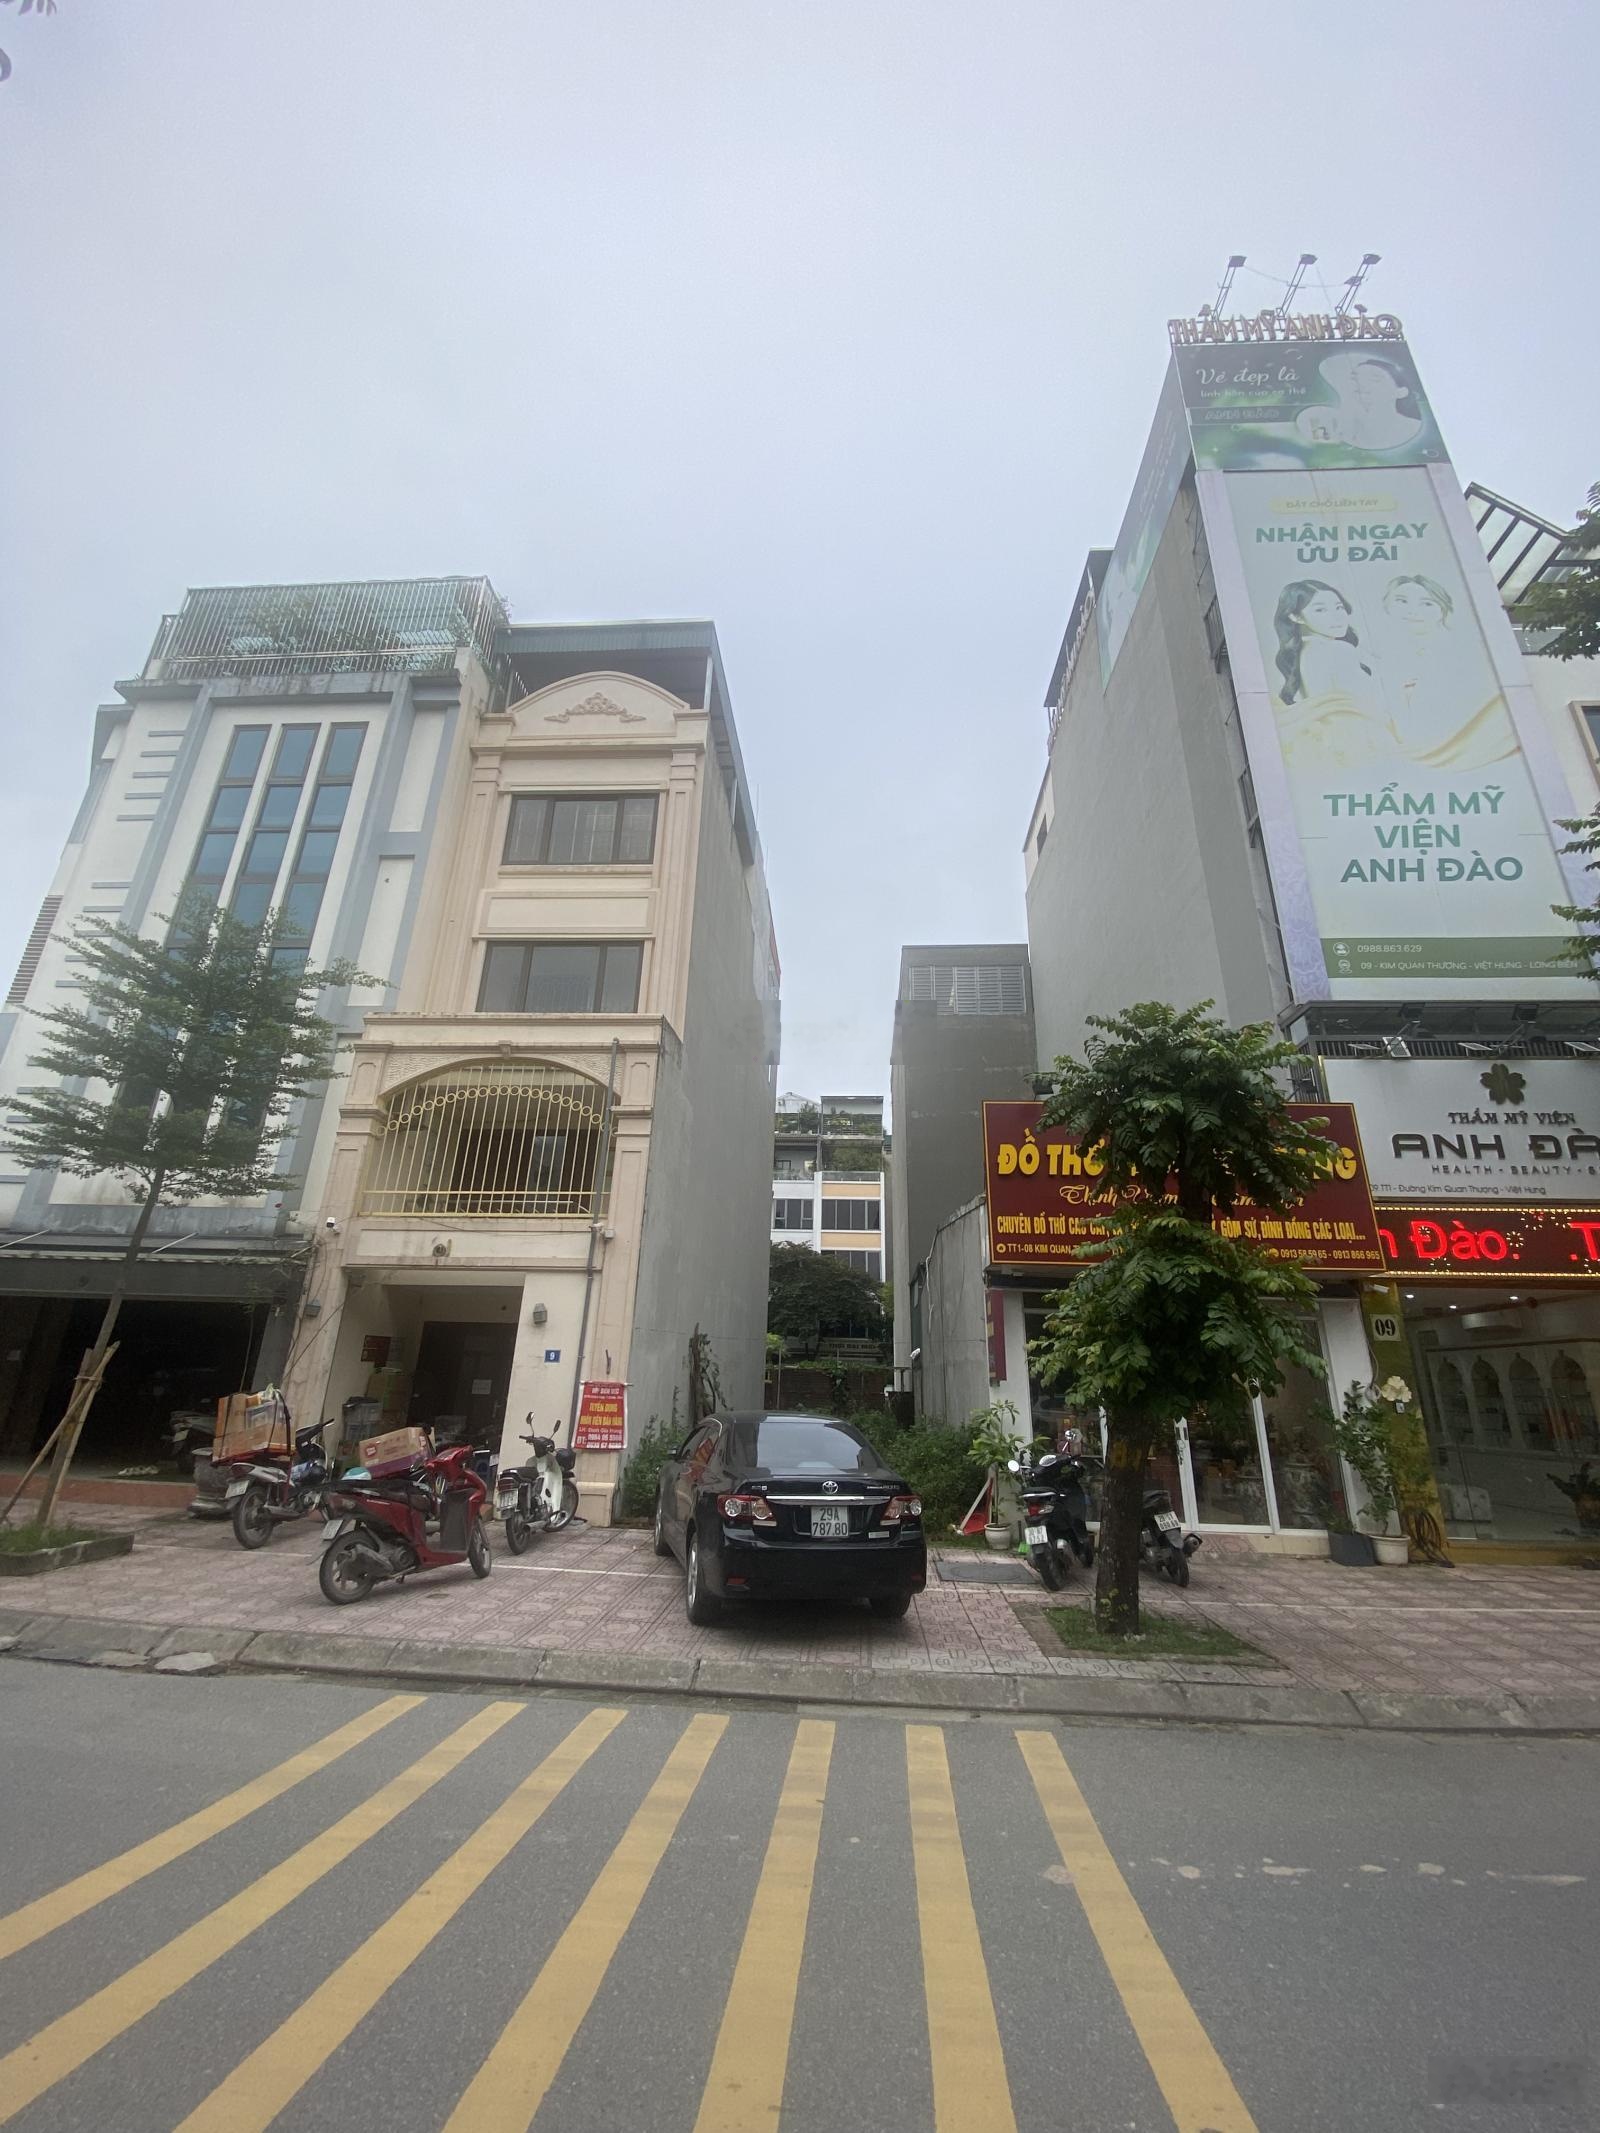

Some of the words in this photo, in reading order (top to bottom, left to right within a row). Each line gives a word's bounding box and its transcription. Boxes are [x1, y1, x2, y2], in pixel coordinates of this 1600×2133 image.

[1284, 312, 1334, 341] ANH
[1233, 367, 1270, 386] đẹp
[1278, 366, 1299, 383] là
[1255, 523, 1339, 547] NHẬN
[1347, 523, 1429, 541] NGAY
[1347, 541, 1399, 562] ĐÃI
[1323, 782, 1435, 817] THẨM
[1448, 785, 1505, 815] MỸ
[1374, 818, 1461, 855] VIỆN
[1340, 857, 1425, 883] ANH
[1436, 850, 1523, 882] ĐÀO
[1380, 961, 1396, 970] KIM
[1398, 961, 1425, 970] QUAN
[1448, 1108, 1498, 1125] THẨM
[1504, 1109, 1529, 1125] MỸ
[1533, 1109, 1576, 1127] VIỆN
[997, 1128, 1040, 1176] ĐỒ
[1391, 1133, 1506, 1160] ANH
[1432, 1165, 1492, 1175] HEALTH
[1511, 1165, 1571, 1176] BEAUTY
[1427, 1184, 1442, 1192] Kim
[1444, 1184, 1467, 1193] Quan
[997, 1212, 1031, 1234] CHUYÊN
[1312, 1217, 1332, 1240] CÁC
[1035, 1244, 1048, 1254] KIM
[1375, 1318, 1396, 1337] 09
[549, 1351, 555, 1361] 9
[819, 1507, 840, 1522] 29A
[812, 1522, 848, 1536] 787.80
